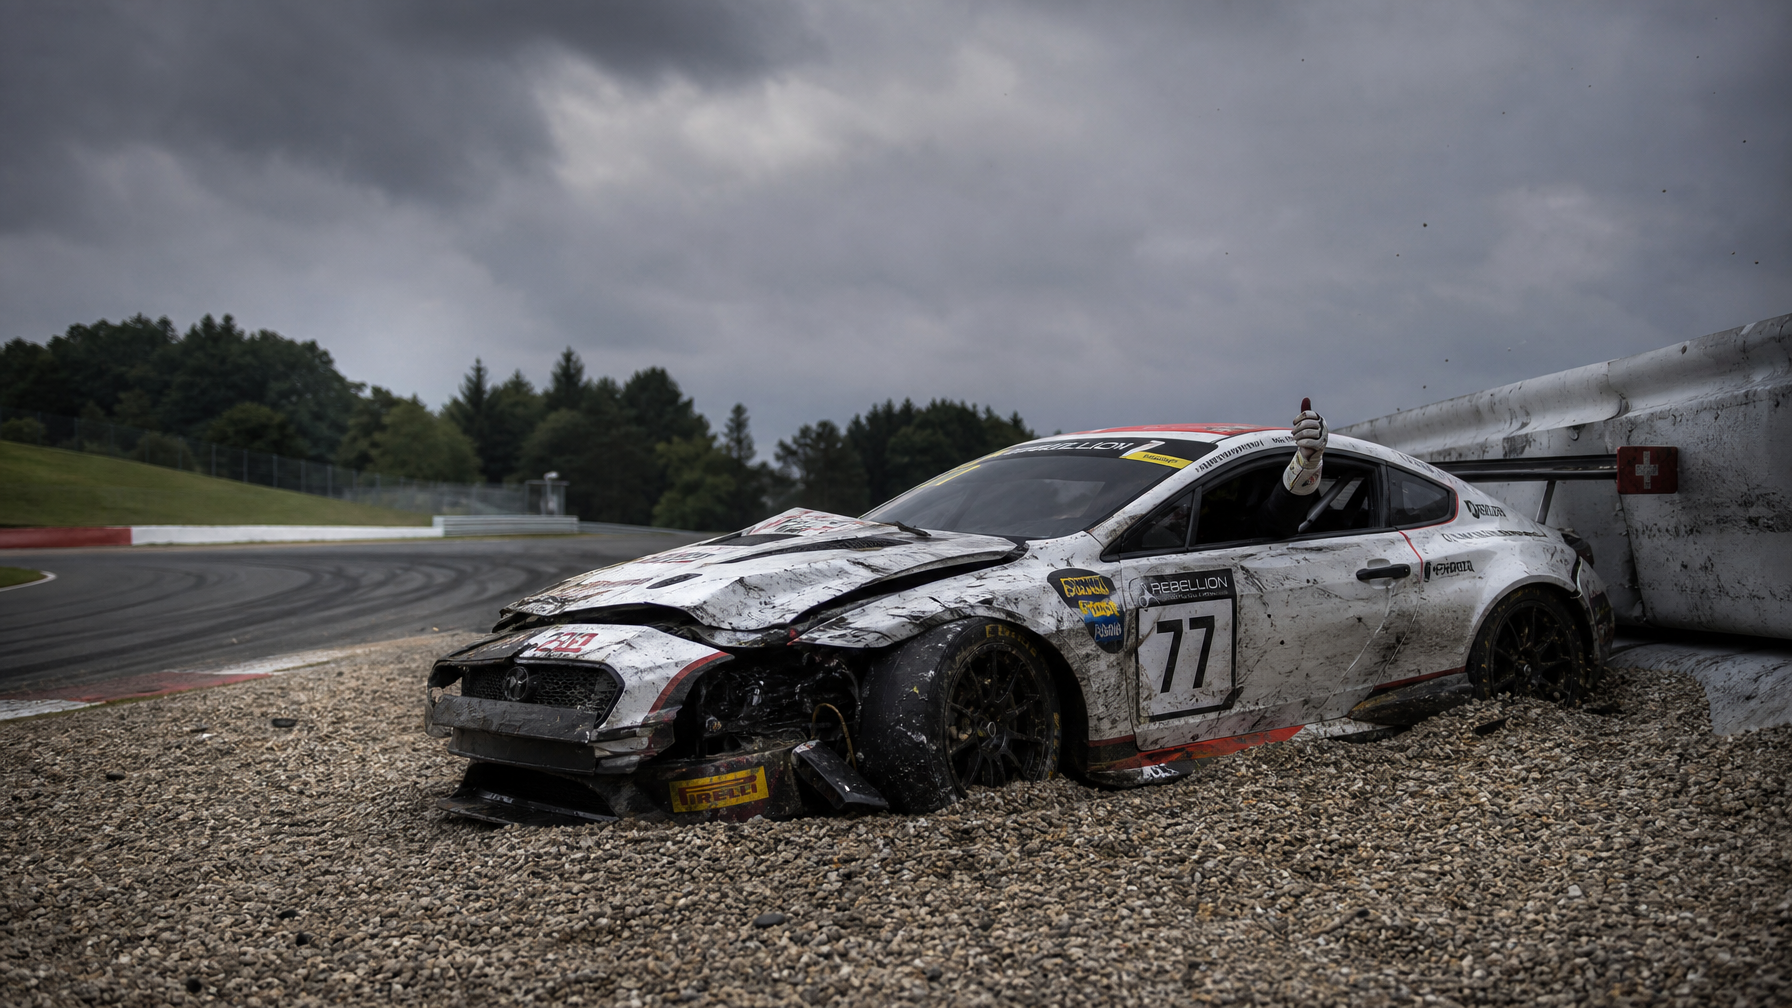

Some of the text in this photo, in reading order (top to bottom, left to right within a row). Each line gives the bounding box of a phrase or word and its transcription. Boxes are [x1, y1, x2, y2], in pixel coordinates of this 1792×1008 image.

[1150, 576, 1228, 594] REBELLION
[1157, 615, 1215, 694] 77
[678, 774, 758, 806] PIRELLI
